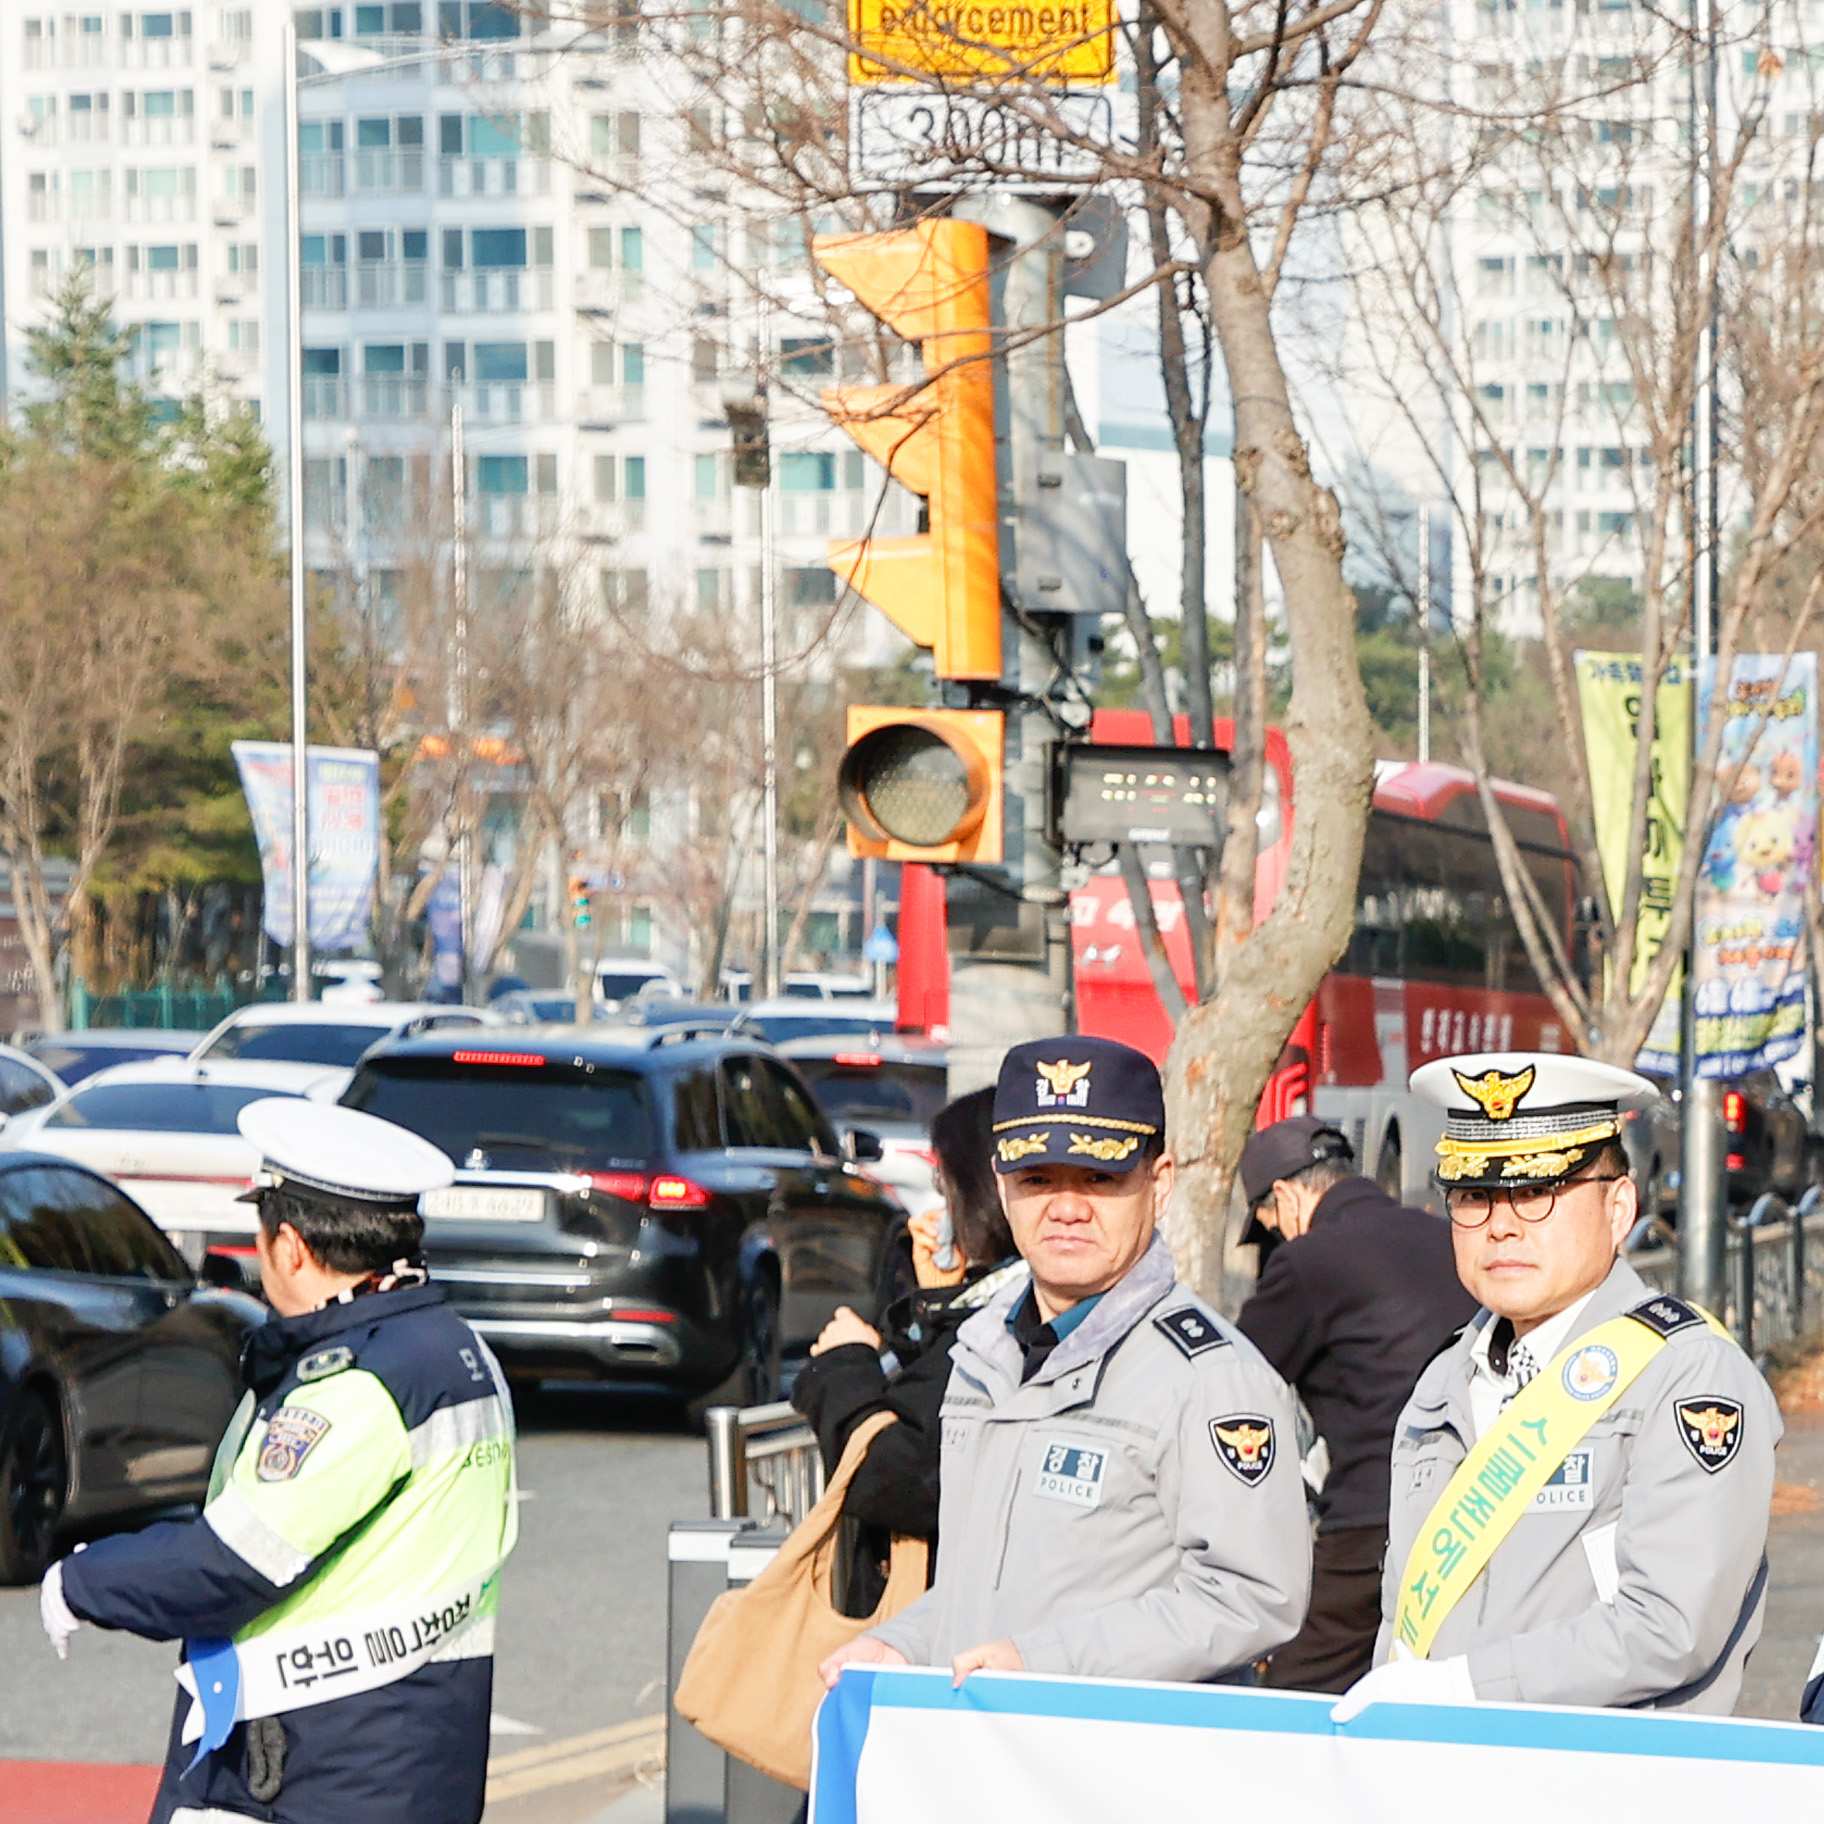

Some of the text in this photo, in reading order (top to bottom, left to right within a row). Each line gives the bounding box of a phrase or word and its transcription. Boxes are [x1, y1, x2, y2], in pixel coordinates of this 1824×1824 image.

[1049, 1446, 1099, 1482] 경찰
[1563, 1455, 1585, 1484] 찰
[1041, 1477, 1094, 1499] POLICE
[278, 1639, 358, 1687] 위한
